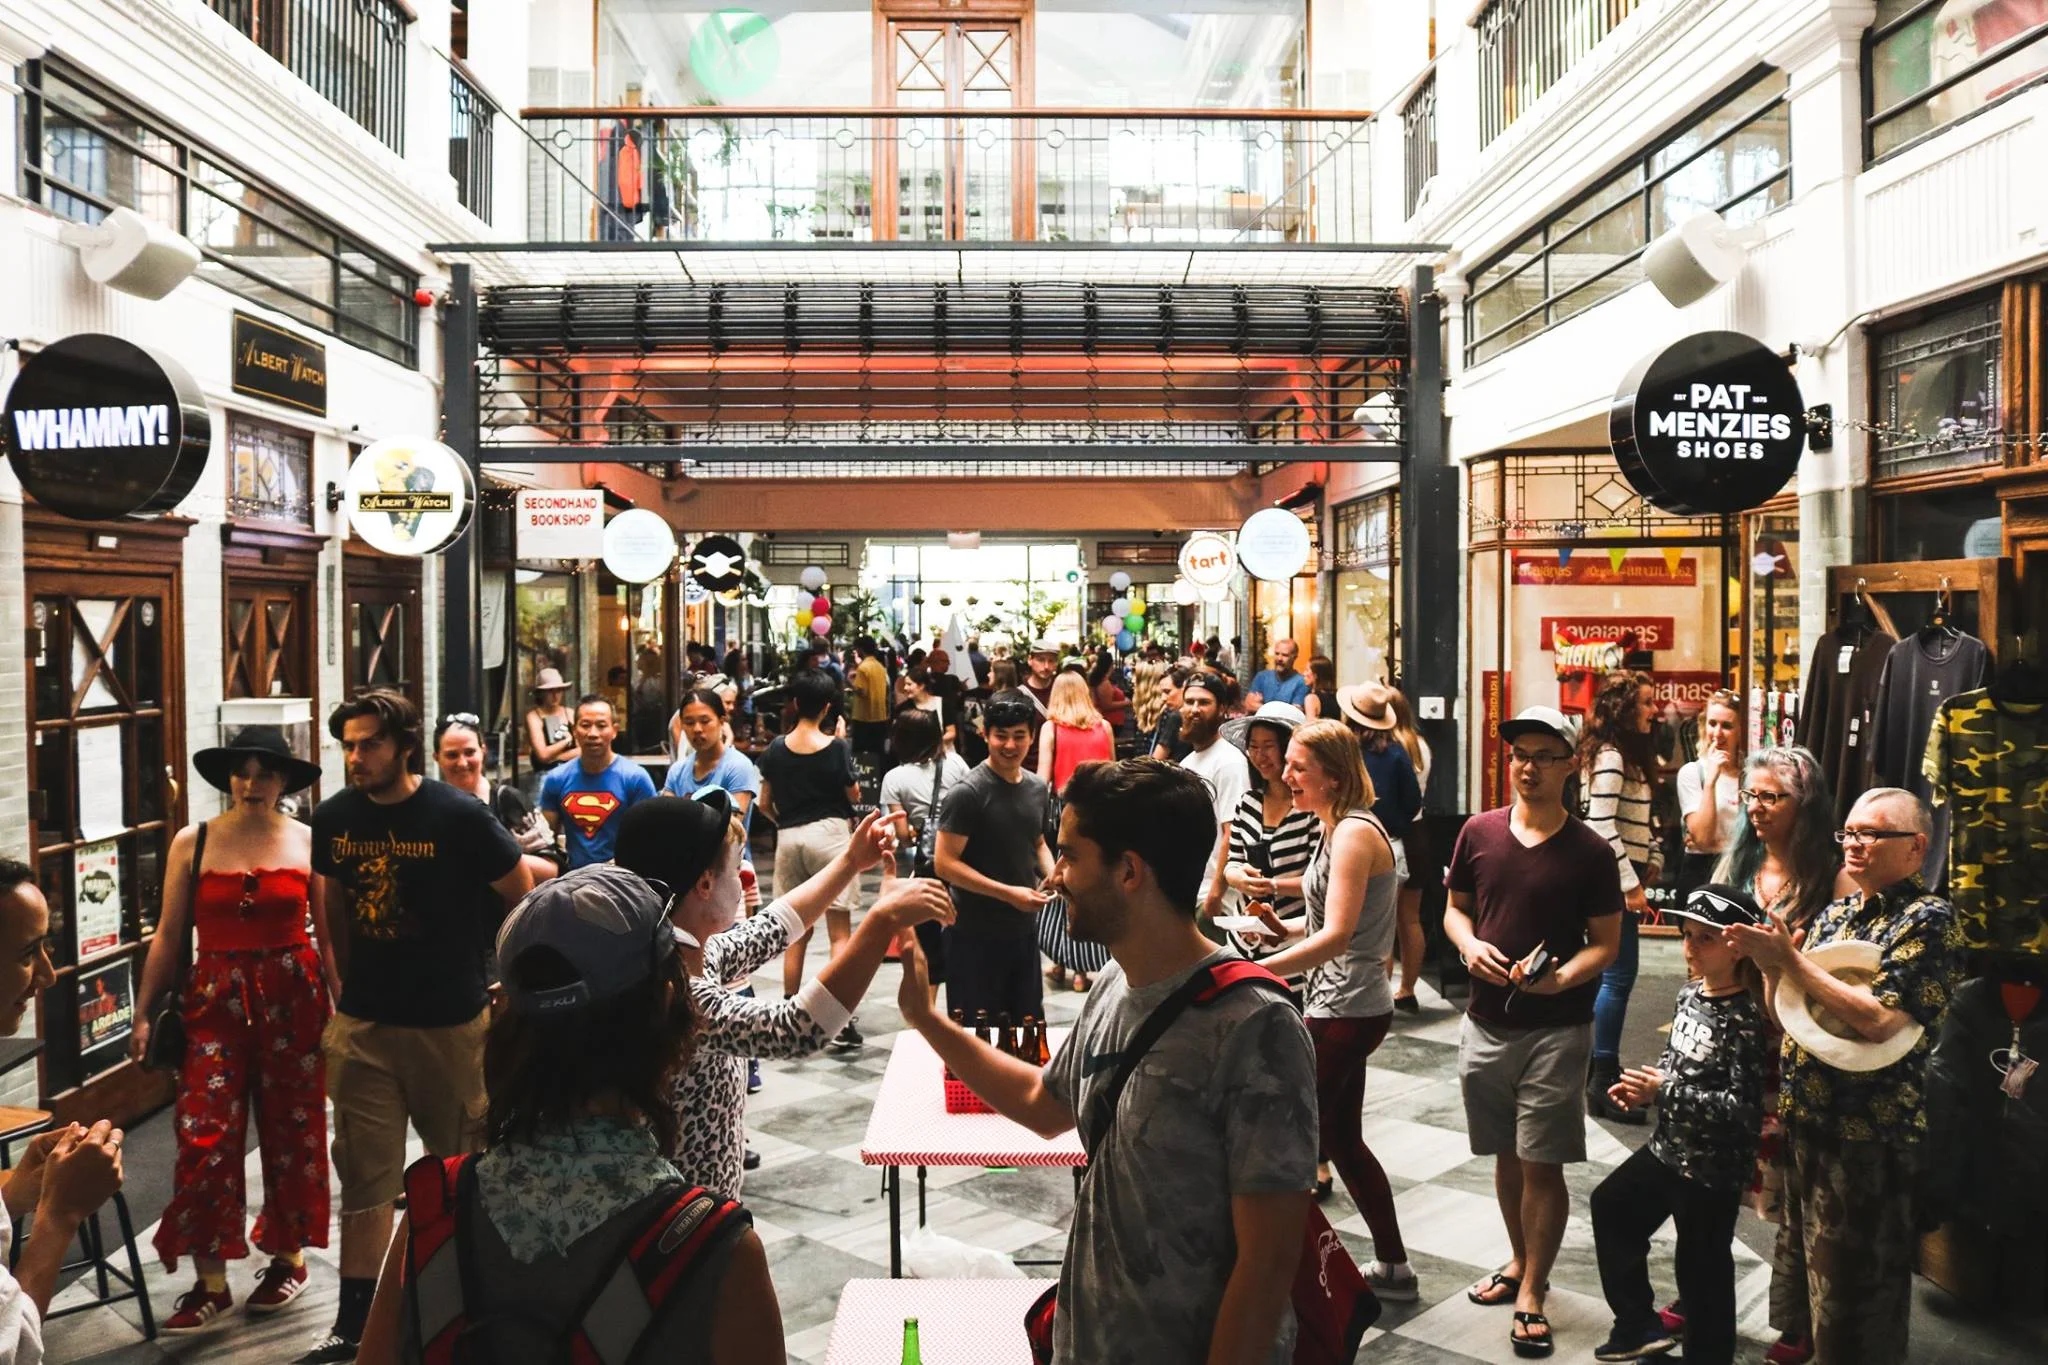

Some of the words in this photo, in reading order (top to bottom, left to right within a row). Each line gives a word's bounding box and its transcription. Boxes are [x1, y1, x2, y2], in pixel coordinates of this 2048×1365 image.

[239, 339, 289, 374] ALBERT
[291, 352, 325, 386] WATCH
[1691, 383, 1751, 410] PAT
[14, 404, 170, 451] WHAMMY!
[1649, 410, 1791, 440] MENZIES
[1677, 440, 1765, 460] SHOES
[361, 496, 406, 509] ALBERT
[409, 496, 449, 509] WATCH
[524, 497, 597, 510] SECONDHAND
[1190, 551, 1227, 570] tart
